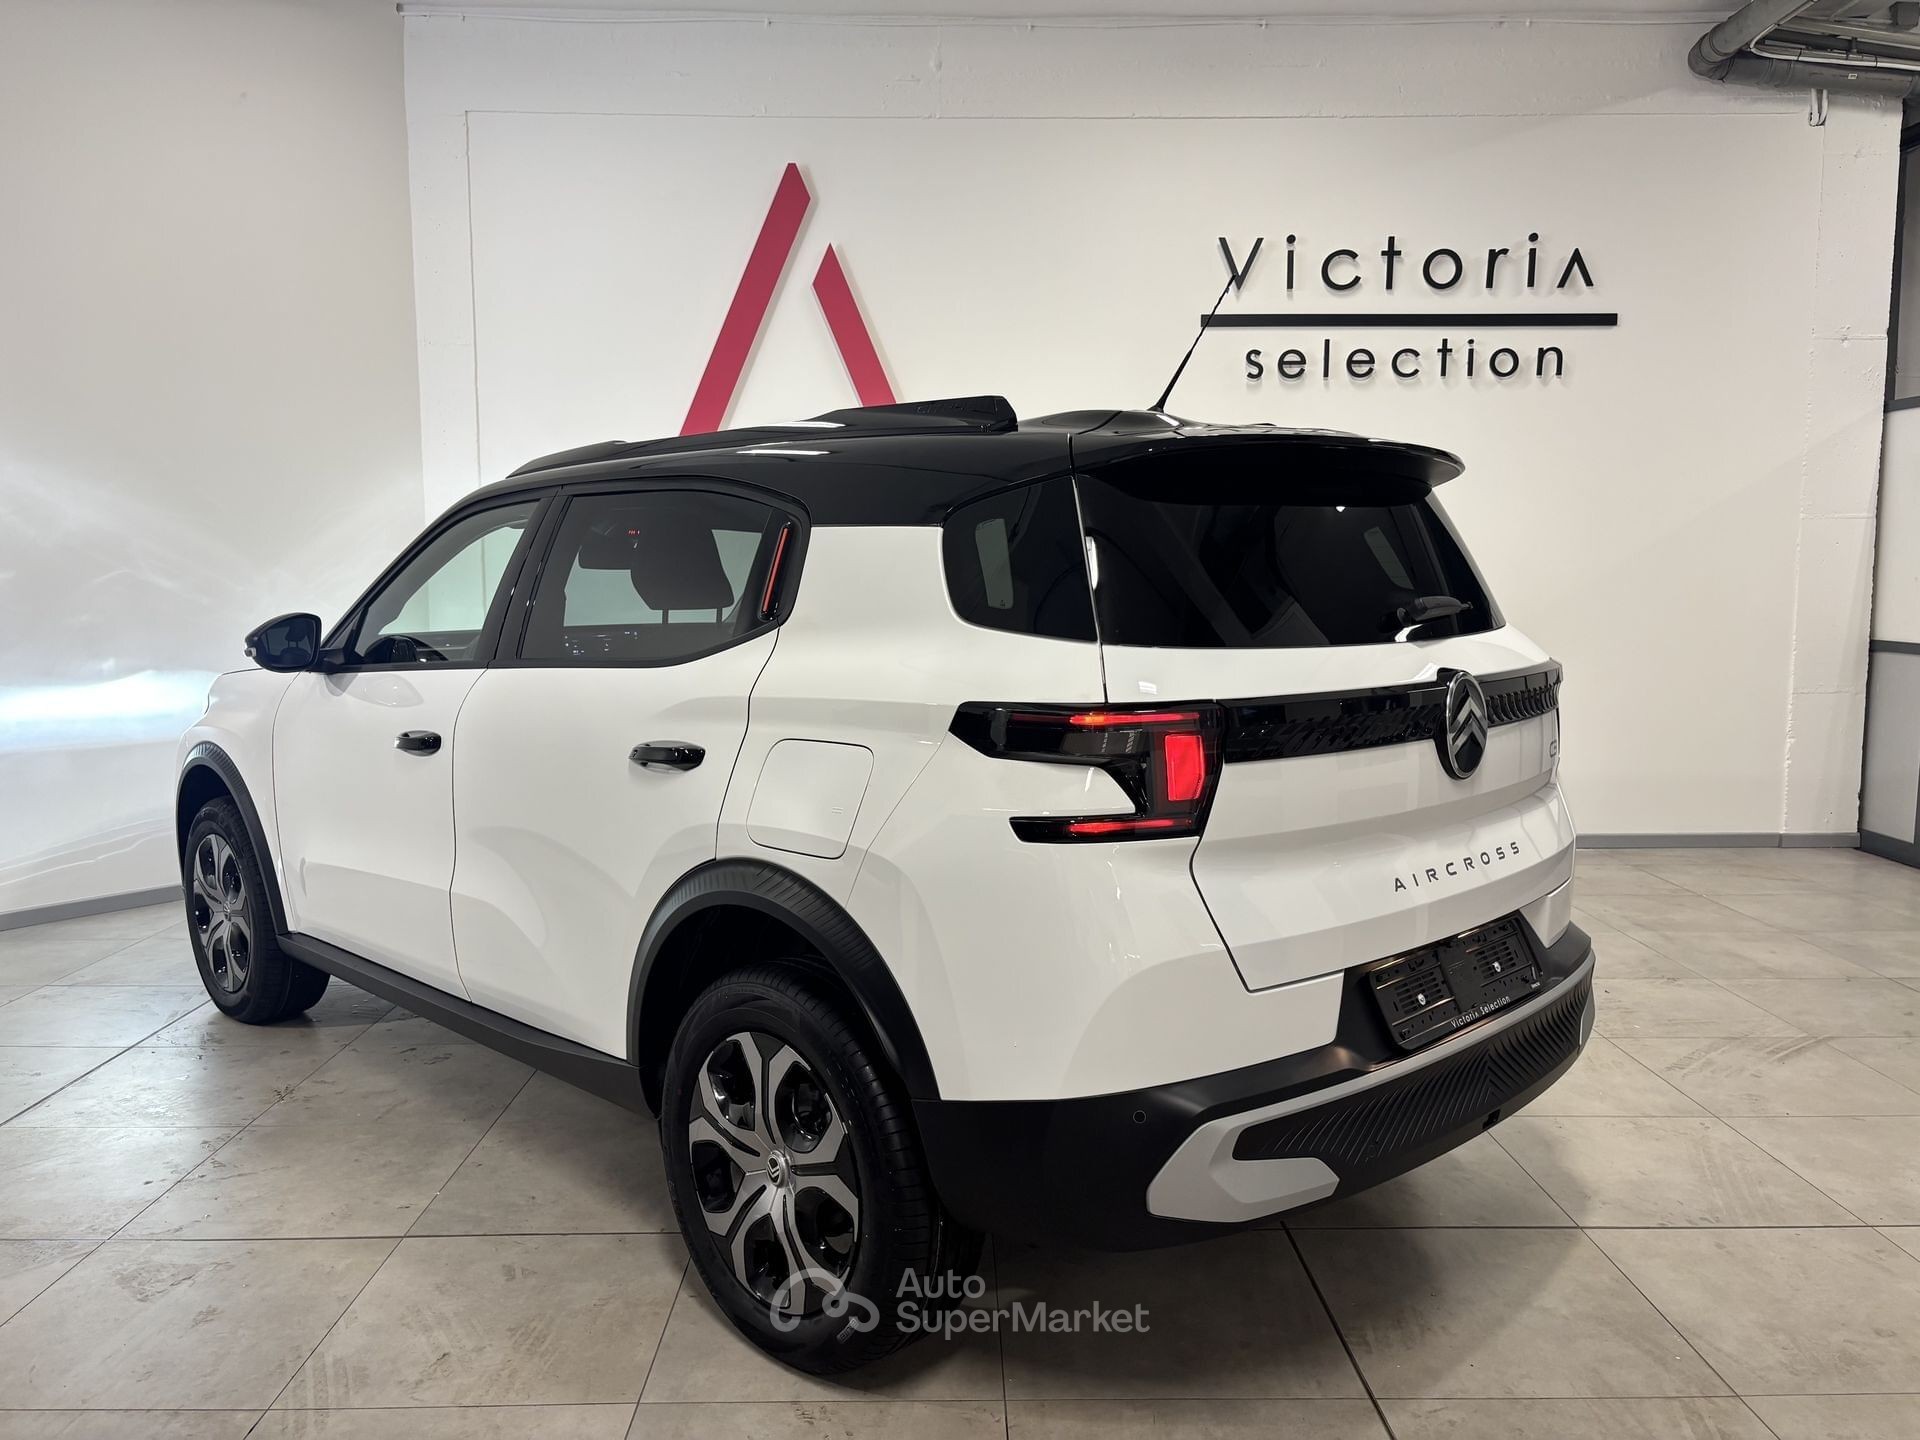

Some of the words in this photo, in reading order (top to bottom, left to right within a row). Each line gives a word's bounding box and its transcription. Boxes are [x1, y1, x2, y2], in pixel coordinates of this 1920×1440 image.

[1245, 338, 1564, 380] selection
[1394, 841, 1520, 892] AIRCROSS
[1480, 995, 1511, 1015] Selection
